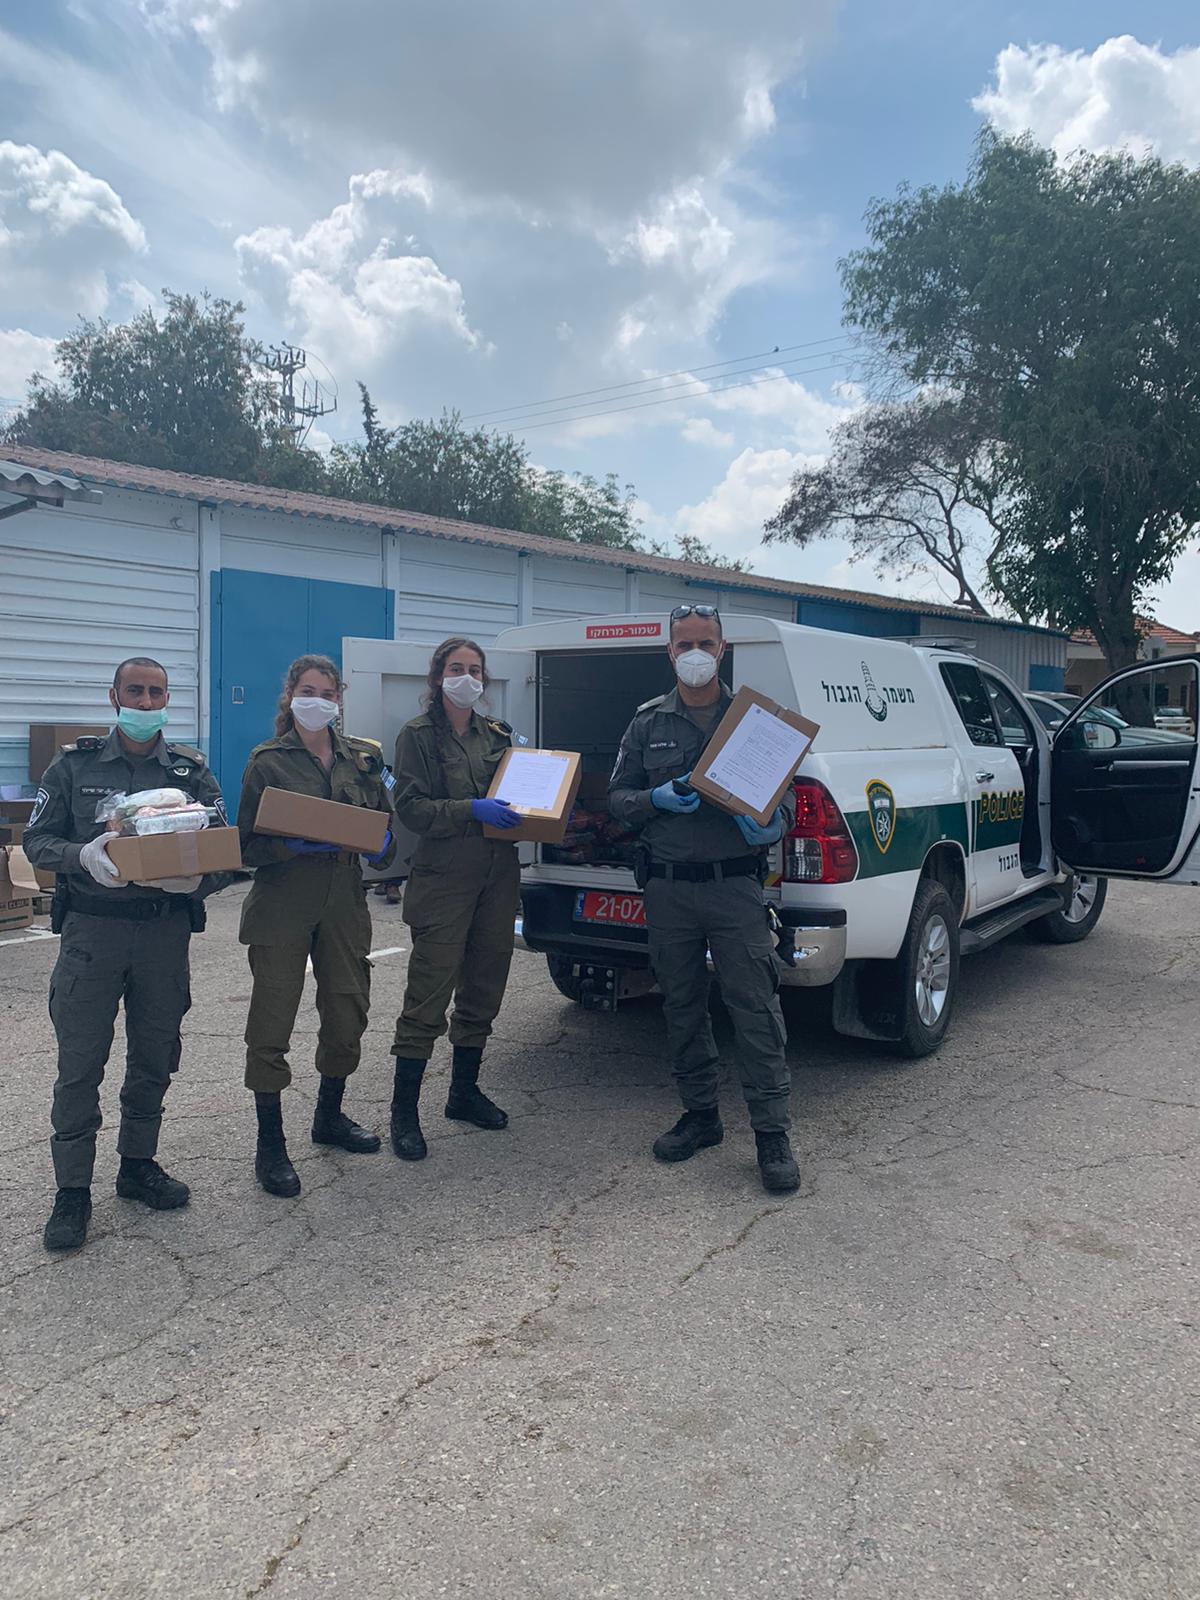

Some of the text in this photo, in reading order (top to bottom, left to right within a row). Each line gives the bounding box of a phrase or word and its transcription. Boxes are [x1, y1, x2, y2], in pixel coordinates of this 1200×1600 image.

[821, 680, 915, 703] משמר הגבול
[979, 789, 1024, 823] POLICE
[998, 853, 1019, 873] הגבול
[596, 896, 647, 921] 21-07
